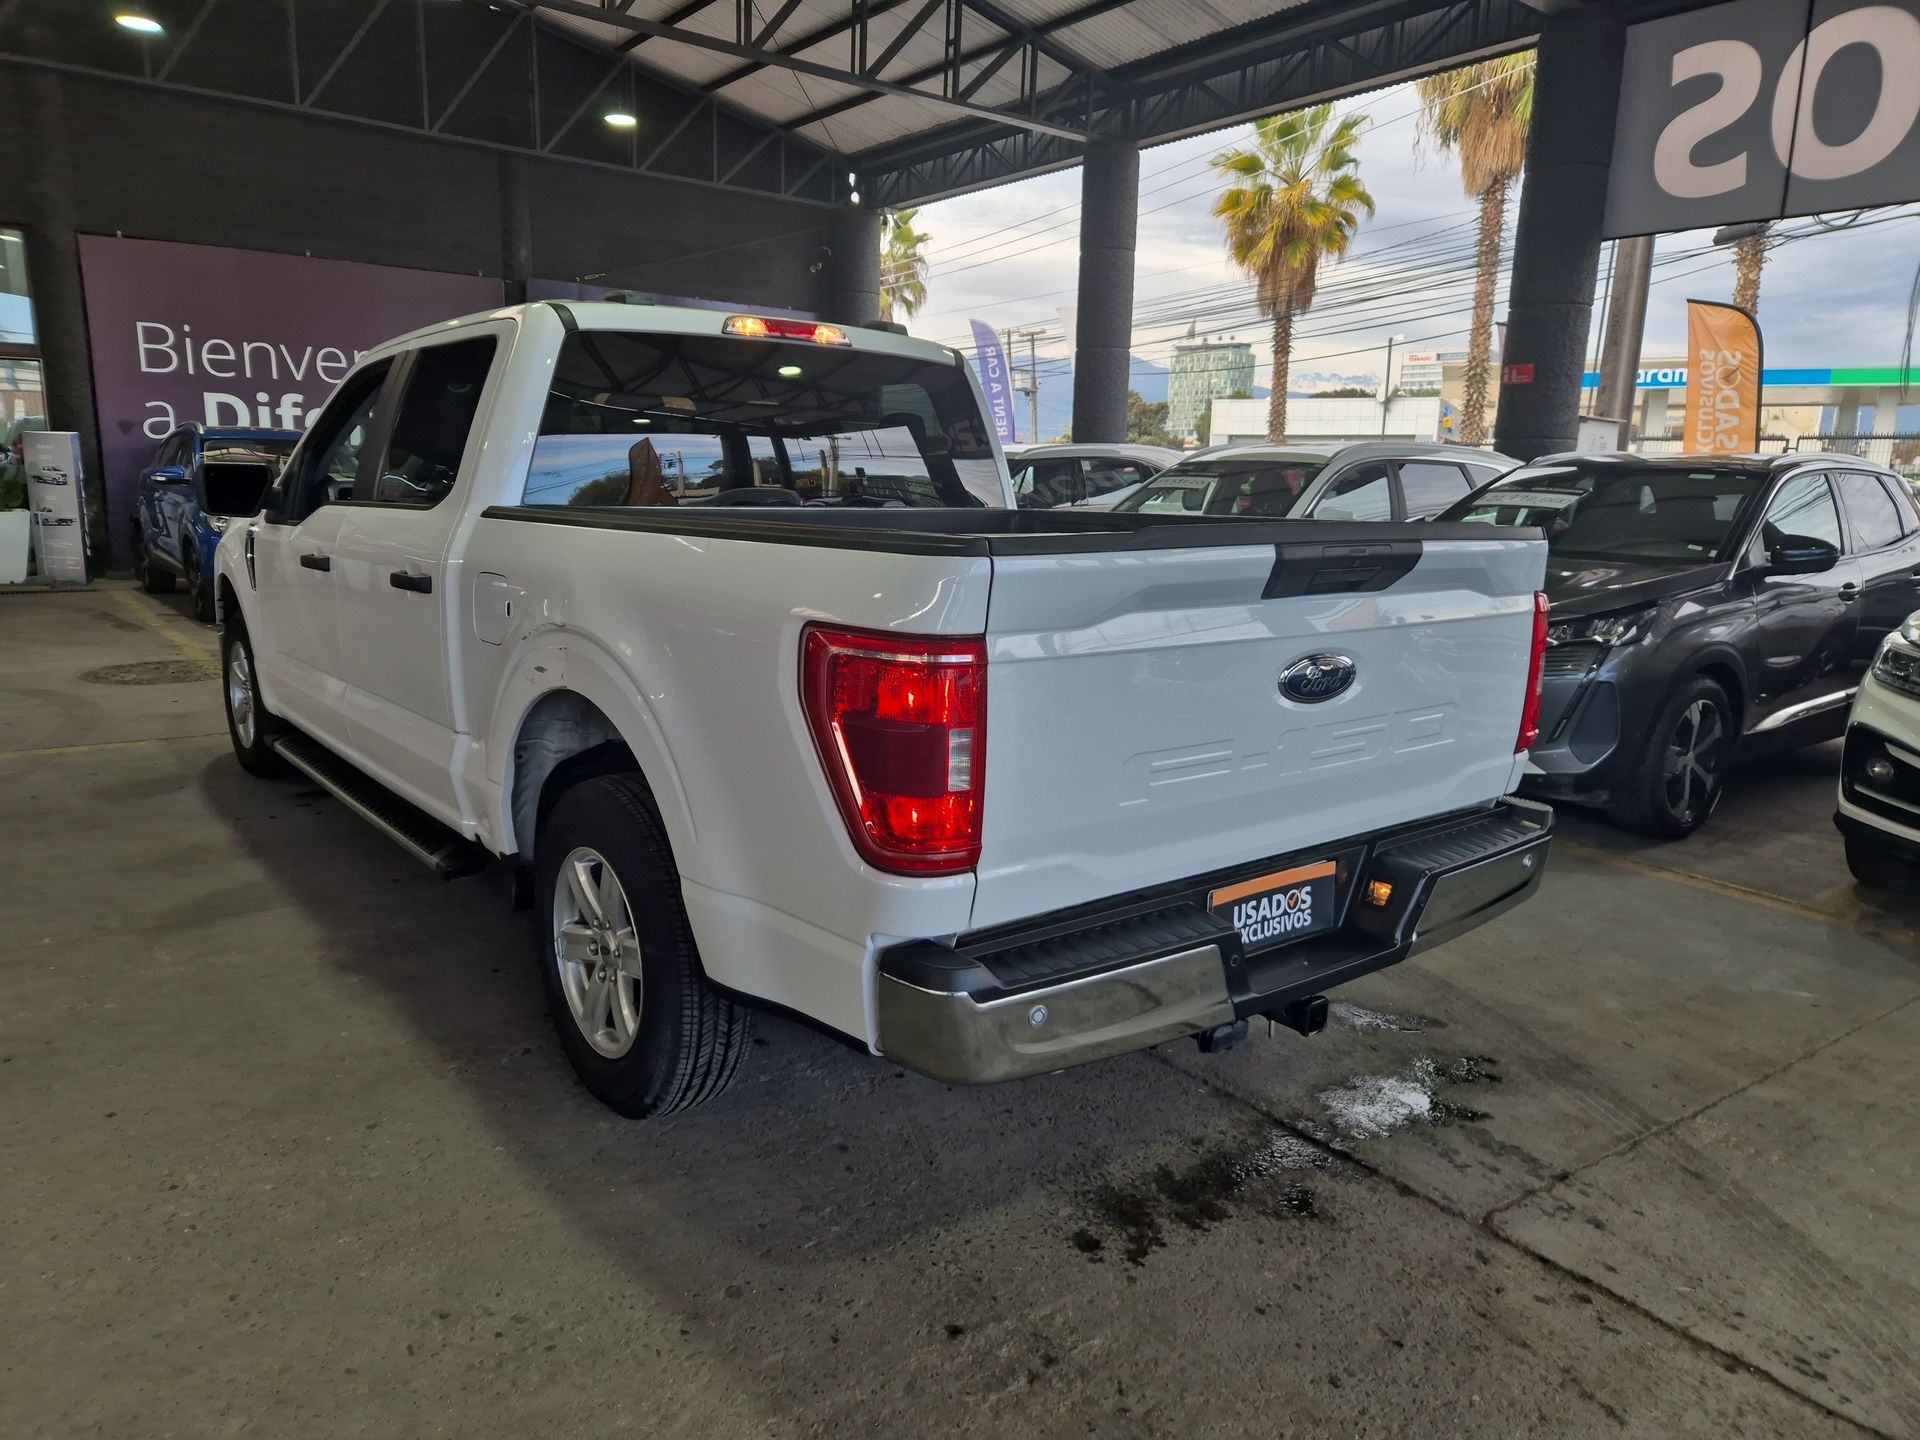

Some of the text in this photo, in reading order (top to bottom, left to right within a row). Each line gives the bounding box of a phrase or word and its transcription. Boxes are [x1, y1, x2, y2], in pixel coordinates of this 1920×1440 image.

[143, 401, 176, 439] a
[1233, 886, 1312, 928] USADOS
[1240, 909, 1312, 944] XCLUSIVOS
